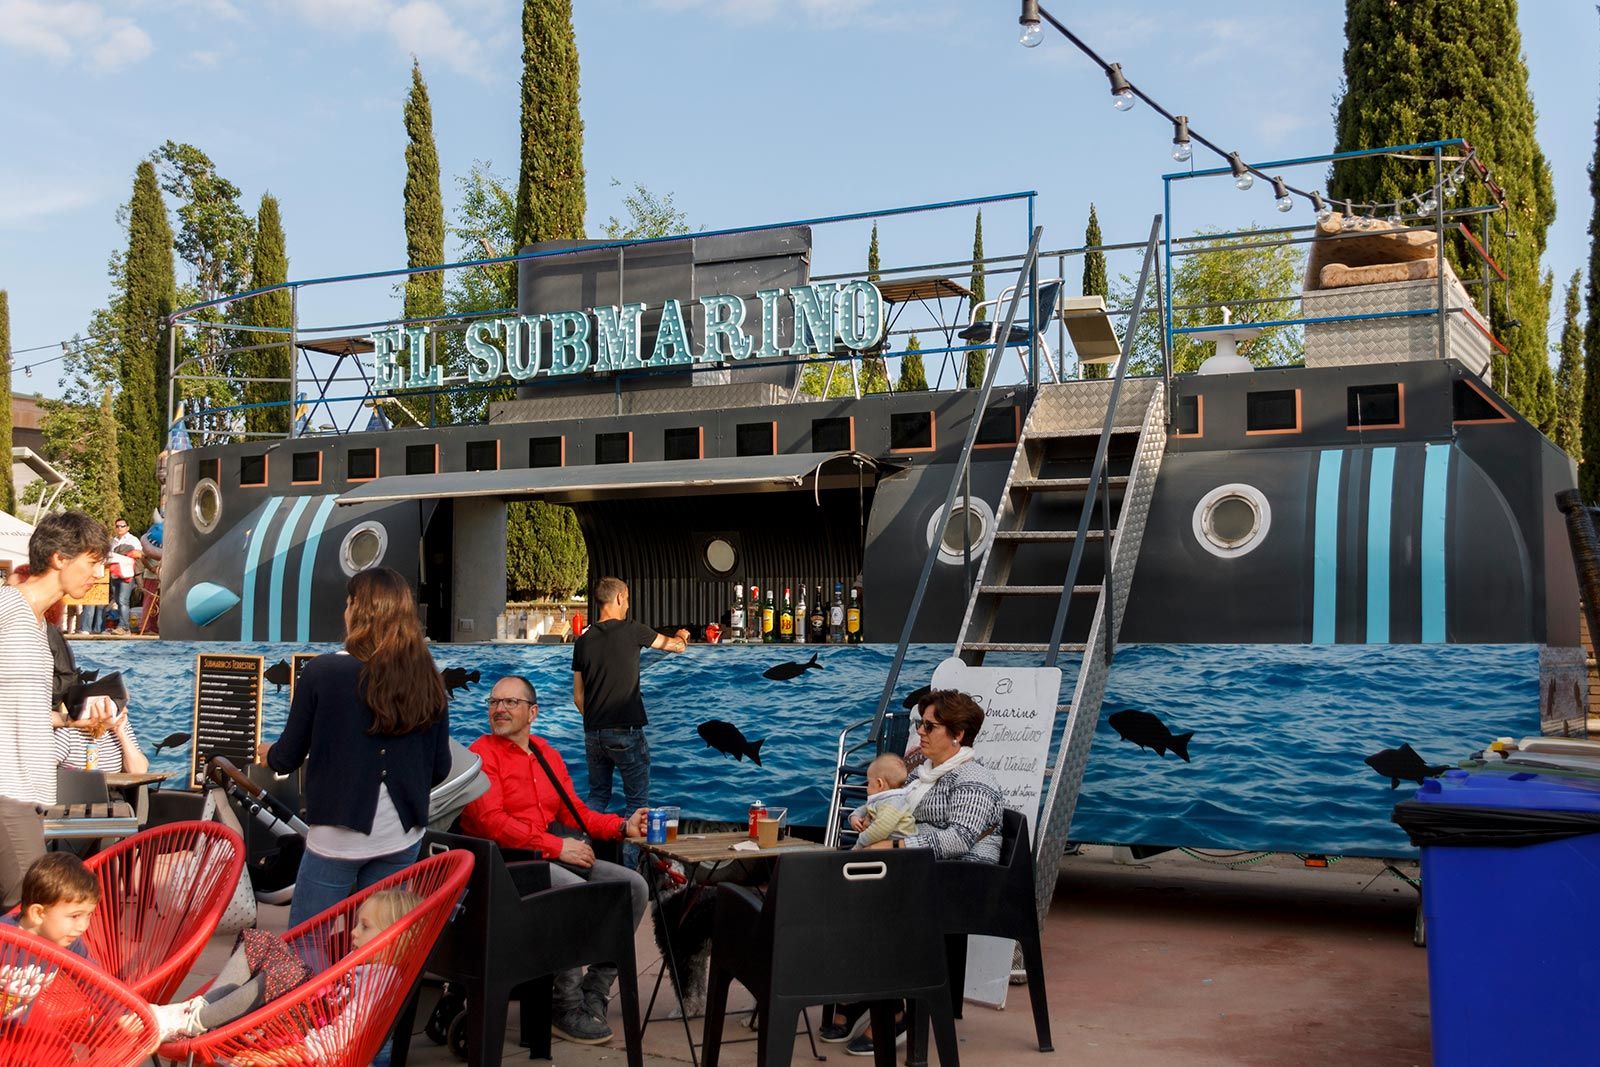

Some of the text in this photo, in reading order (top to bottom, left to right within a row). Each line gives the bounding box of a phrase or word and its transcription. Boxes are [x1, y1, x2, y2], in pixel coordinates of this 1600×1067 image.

[370, 279, 885, 391] EL SUBMARINO
[995, 677, 1013, 695] El
